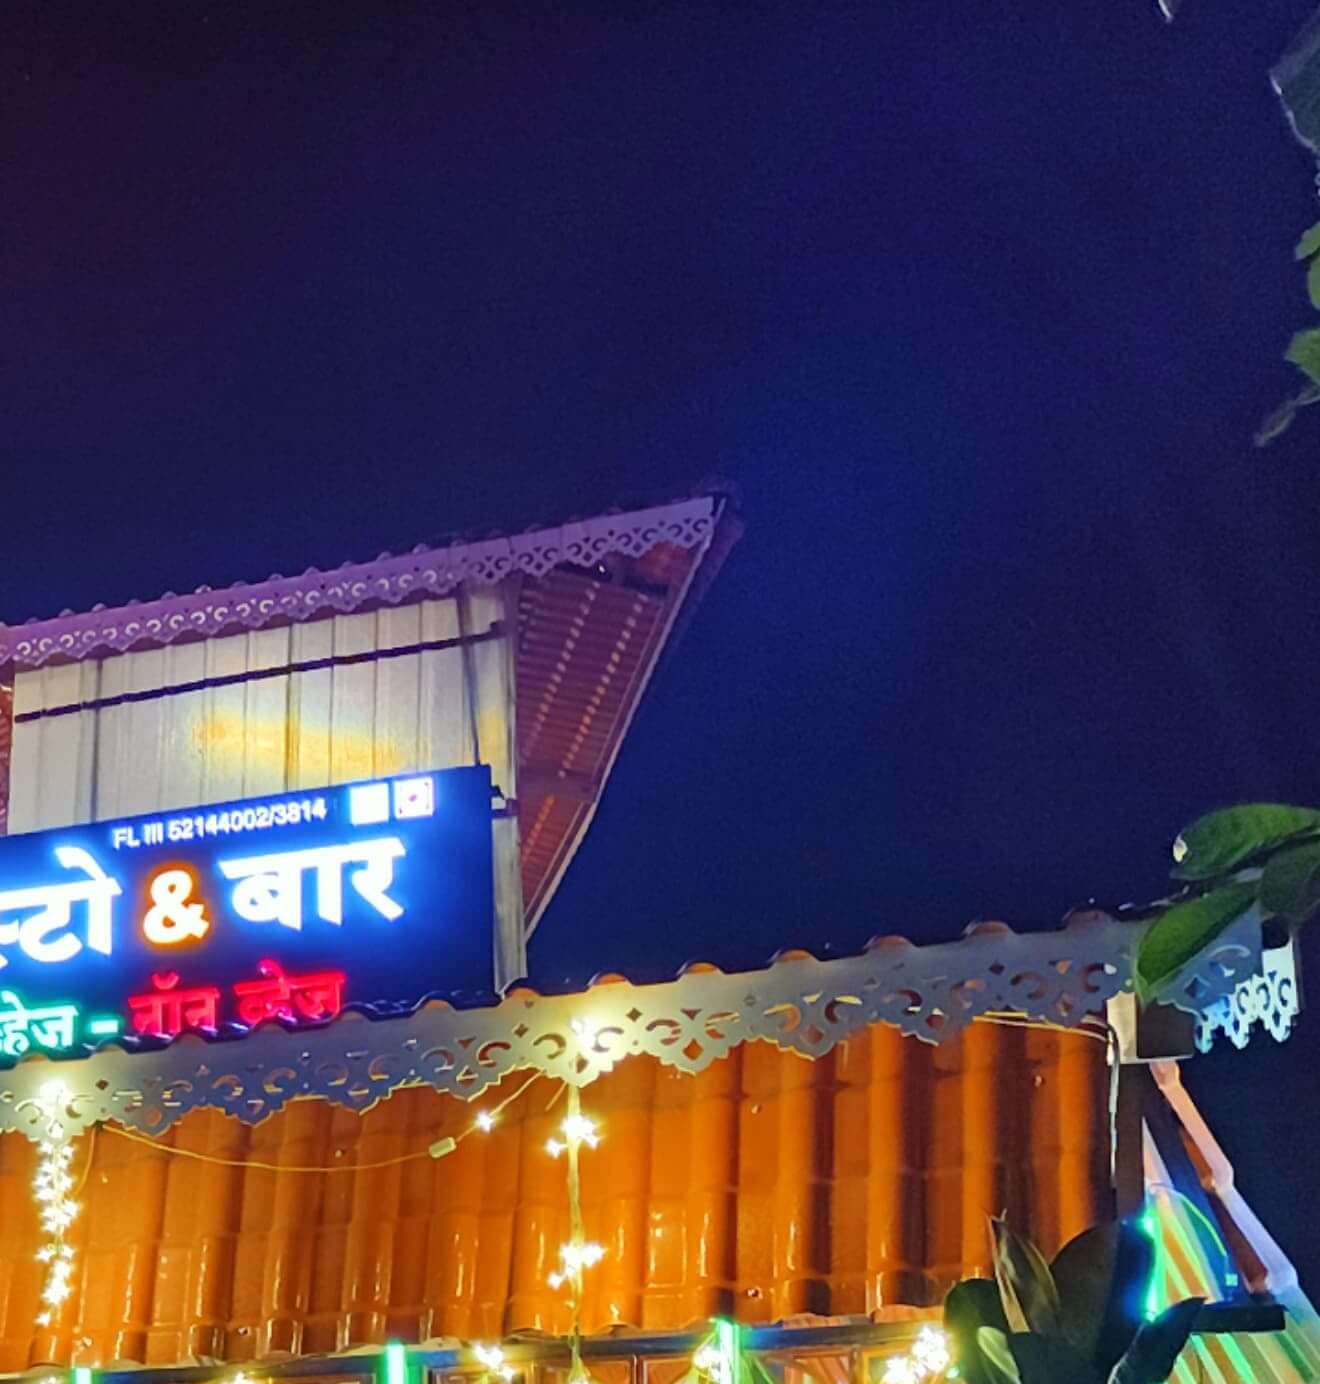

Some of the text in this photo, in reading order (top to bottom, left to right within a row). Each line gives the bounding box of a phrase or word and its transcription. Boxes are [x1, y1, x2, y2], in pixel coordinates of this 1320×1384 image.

[113, 827, 140, 849] FL
[143, 869, 209, 944] &
[218, 838, 406, 931] बार
[128, 972, 221, 1035] नॉन
[233, 958, 347, 1027] व्हेज
